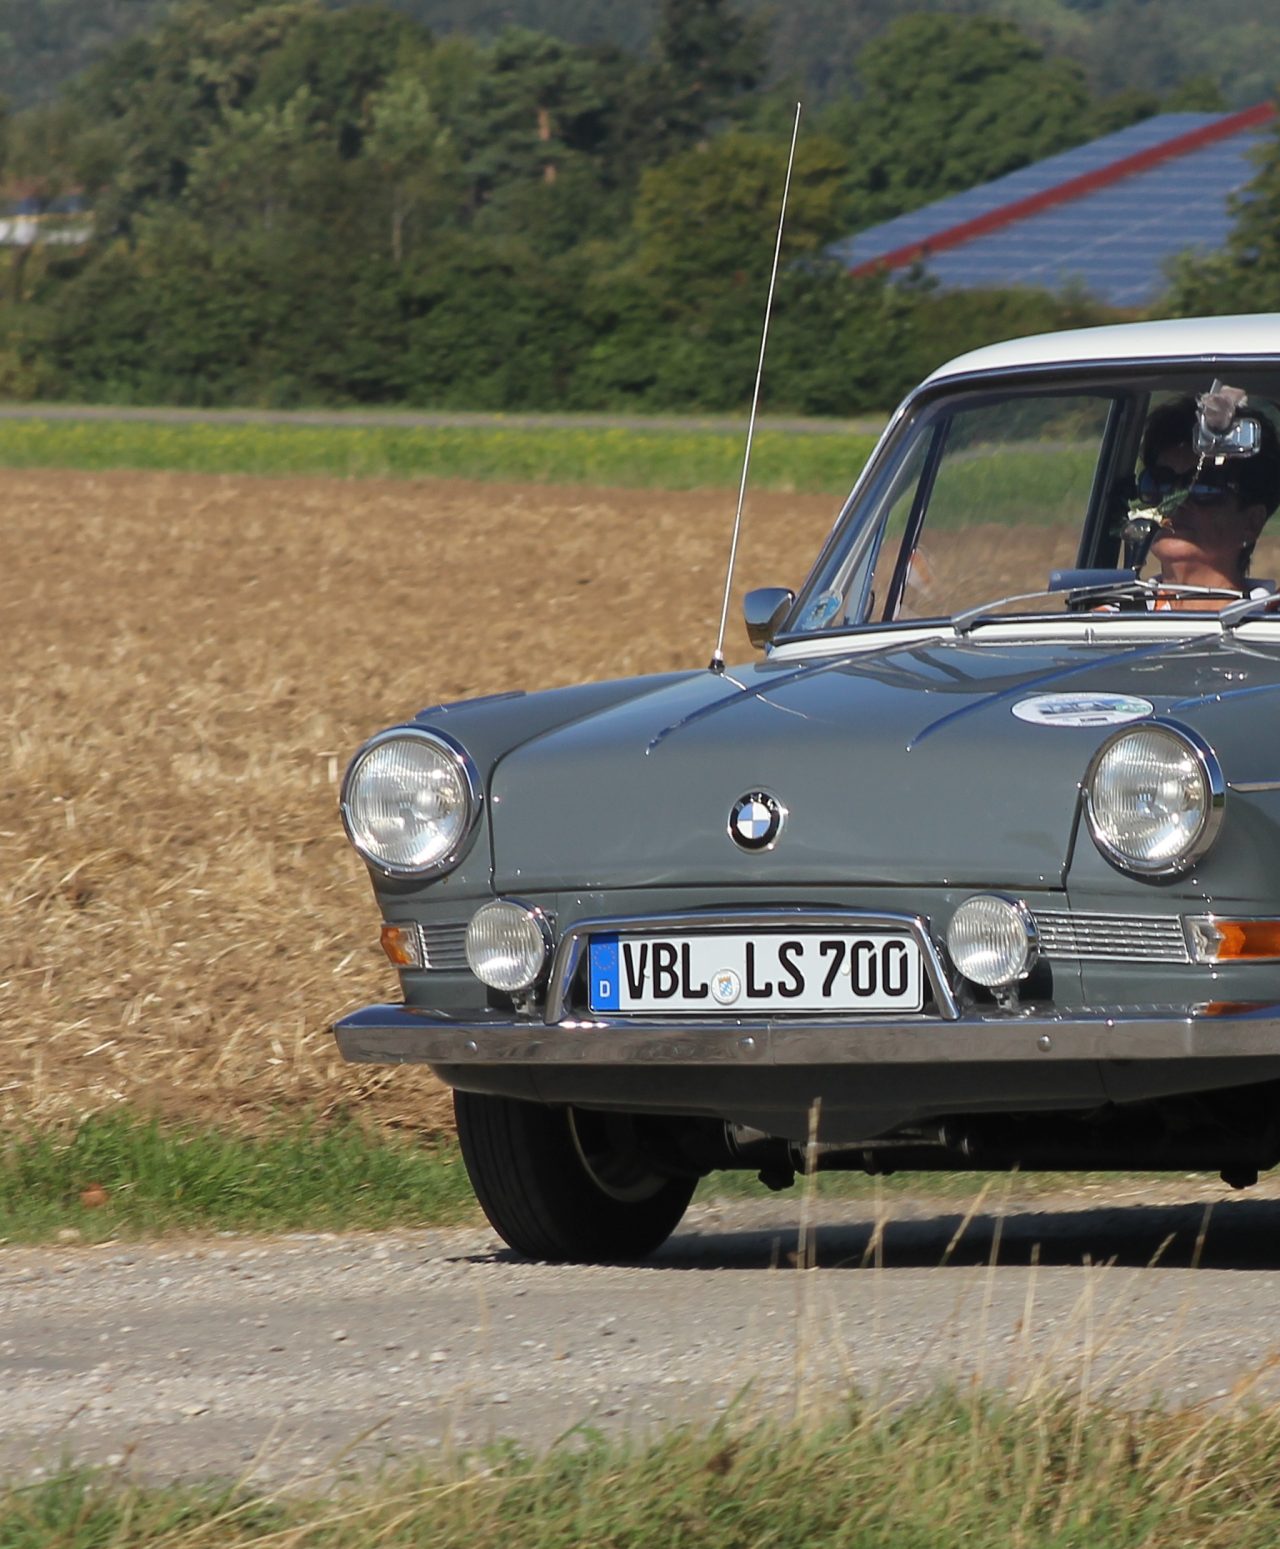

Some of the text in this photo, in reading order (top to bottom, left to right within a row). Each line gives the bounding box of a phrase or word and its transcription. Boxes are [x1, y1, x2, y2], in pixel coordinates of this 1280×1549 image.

[622, 940, 908, 999] VBL LS 700
[600, 980, 611, 998] D
